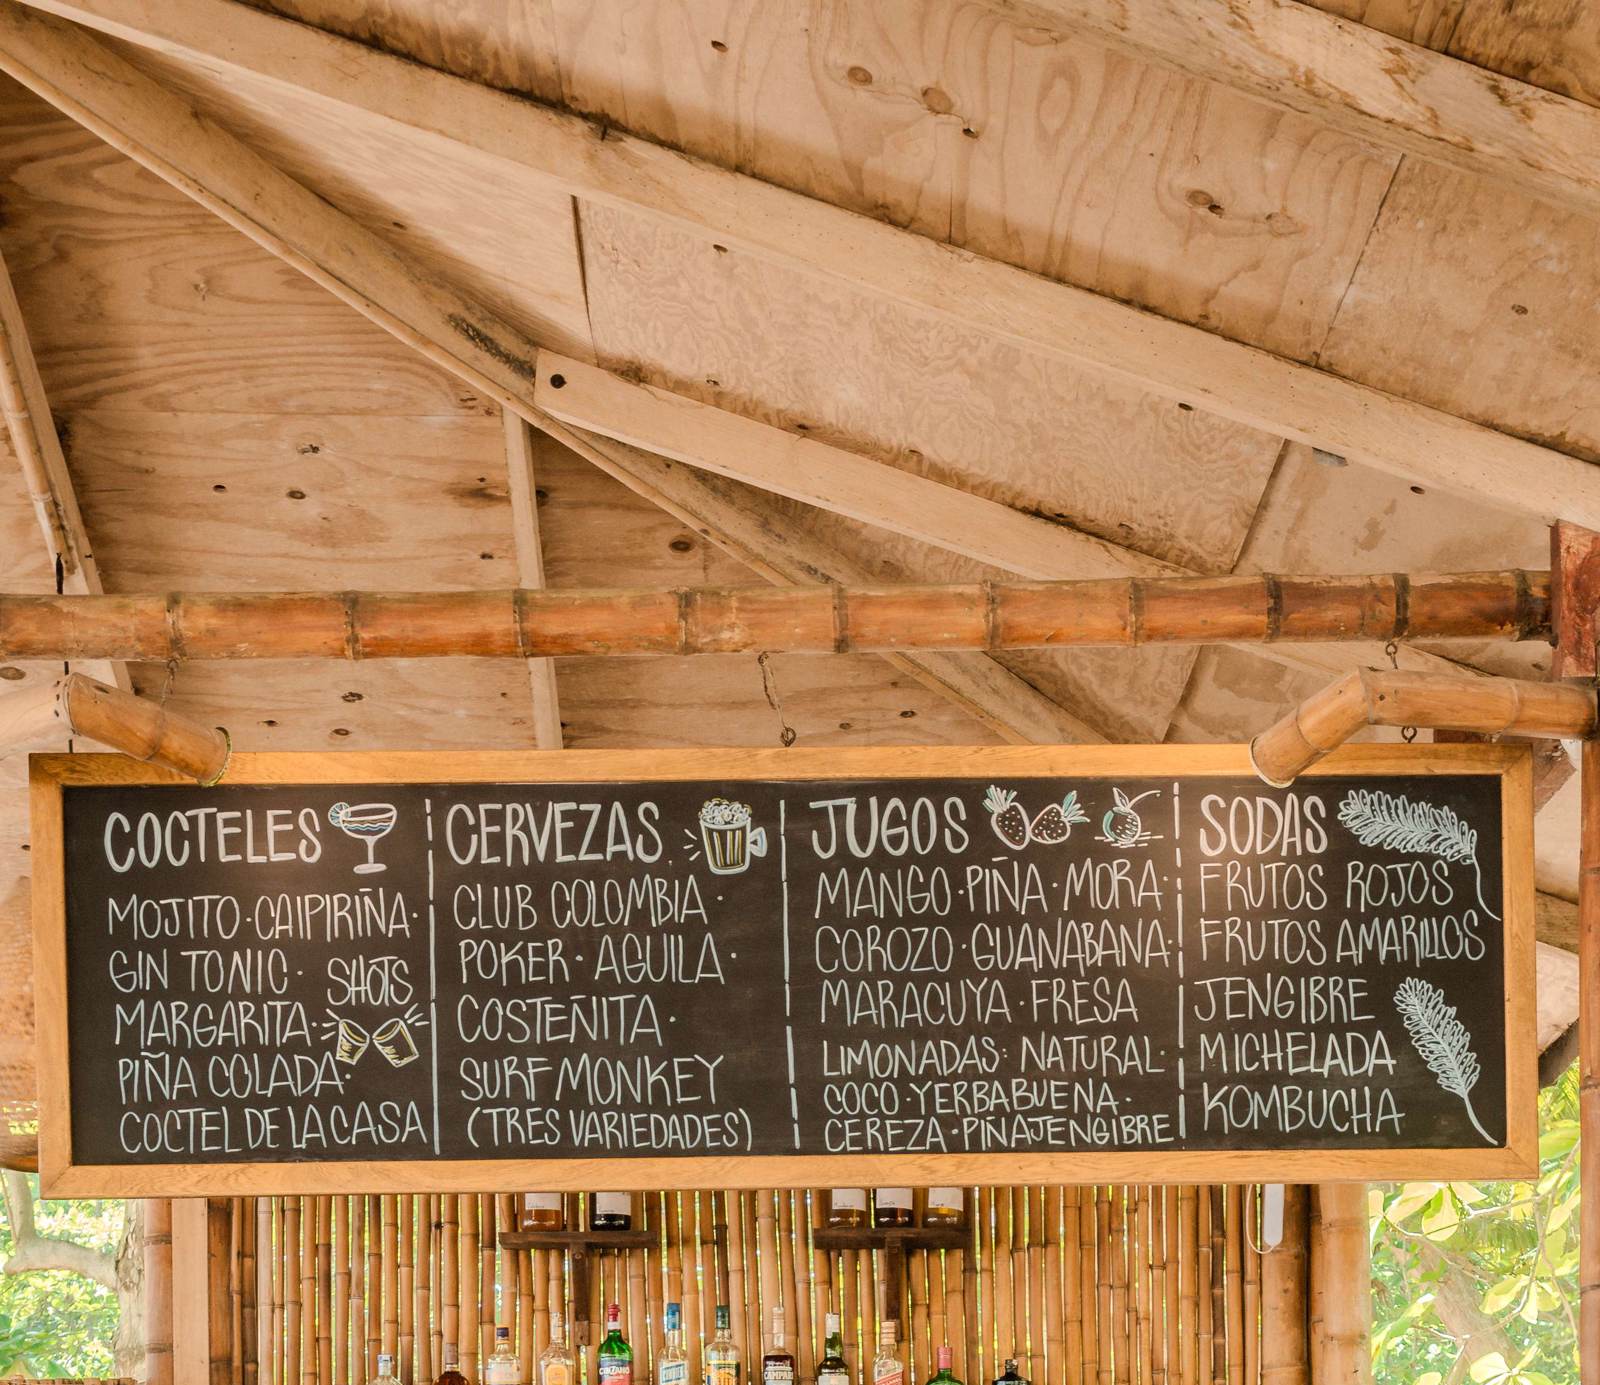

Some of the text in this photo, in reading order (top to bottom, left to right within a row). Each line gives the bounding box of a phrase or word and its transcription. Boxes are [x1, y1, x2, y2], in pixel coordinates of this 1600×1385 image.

[104, 807, 322, 873] COCTELES
[446, 801, 663, 867] CERVEZAS
[809, 795, 970, 860] JUGOS
[1199, 793, 1328, 857] SODAS
[453, 874, 709, 931] CLUB COLOMBIA
[814, 856, 1164, 919] MANGO PIÑA MORA
[1200, 859, 1454, 912] FRUTOS ROJOS
[108, 887, 411, 942] MOJITO CAIPIRIÑA
[1200, 909, 1486, 967] FRUTOS AMARILLOS
[109, 947, 289, 995] GIN TONIC
[459, 932, 725, 986] POKER AGUILA
[815, 918, 1170, 977] COROZO GUANABANA
[326, 954, 414, 1007] SHOTS
[821, 976, 1139, 1029] MARACUYA FRESA
[1194, 972, 1375, 1024] JENGIBRE
[115, 999, 312, 1048] MARGARITA
[457, 994, 663, 1047] COSTEÑITA
[118, 1051, 345, 1105] PIÑA COLADA
[460, 1052, 724, 1107] SURF MONKEY
[823, 1031, 1165, 1079] LIMONADAS: NATURAL
[1200, 1030, 1397, 1079] MICHELADA
[823, 1077, 1119, 1116] COCO YERBABUENA
[1202, 1082, 1406, 1136] KOMBUCHA
[120, 1106, 242, 1154] COCTEL
[330, 1100, 428, 1145] CASA
[467, 1106, 753, 1152] (TRES VARIEDADES)
[824, 1116, 947, 1153] CEREZA
